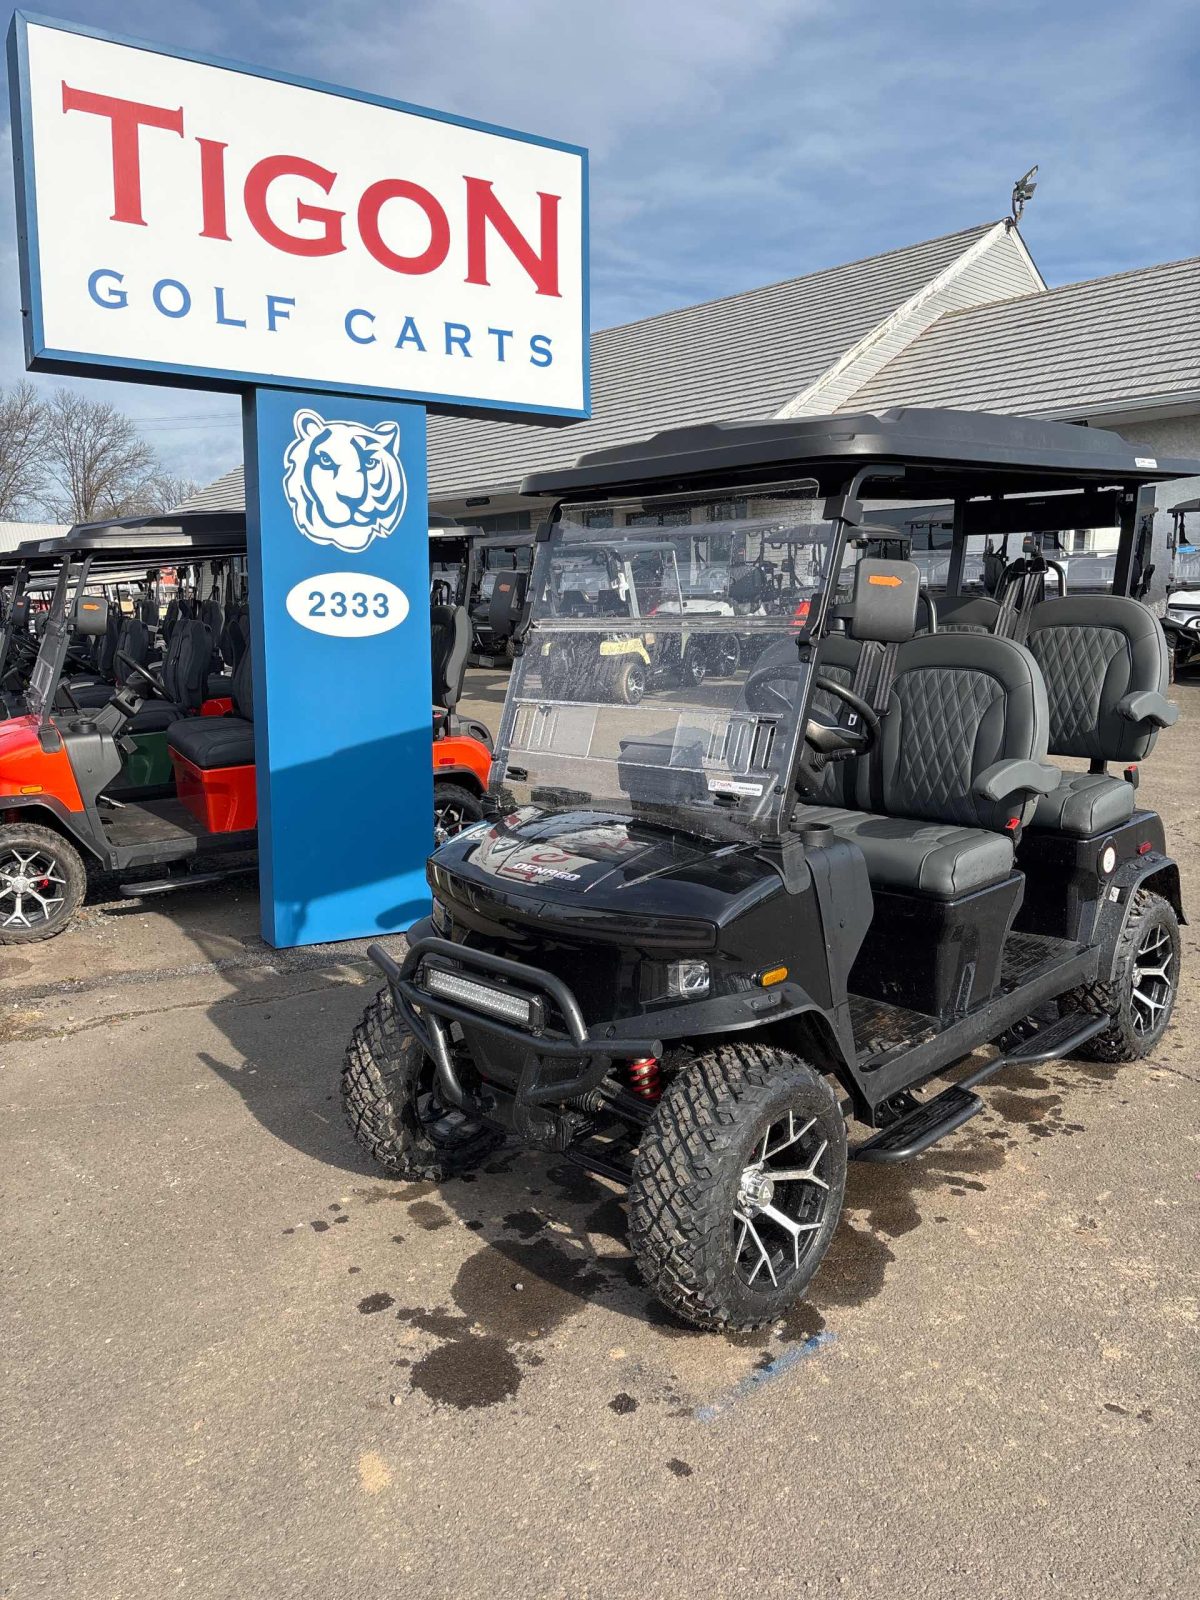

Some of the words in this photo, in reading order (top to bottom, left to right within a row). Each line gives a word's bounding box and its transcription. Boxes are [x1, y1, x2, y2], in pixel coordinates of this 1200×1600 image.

[62, 80, 561, 298] TIGON
[87, 268, 296, 331] GOLF
[344, 308, 554, 368] CARTS
[308, 591, 390, 619] 2333
[512, 862, 581, 882] DENAGO
